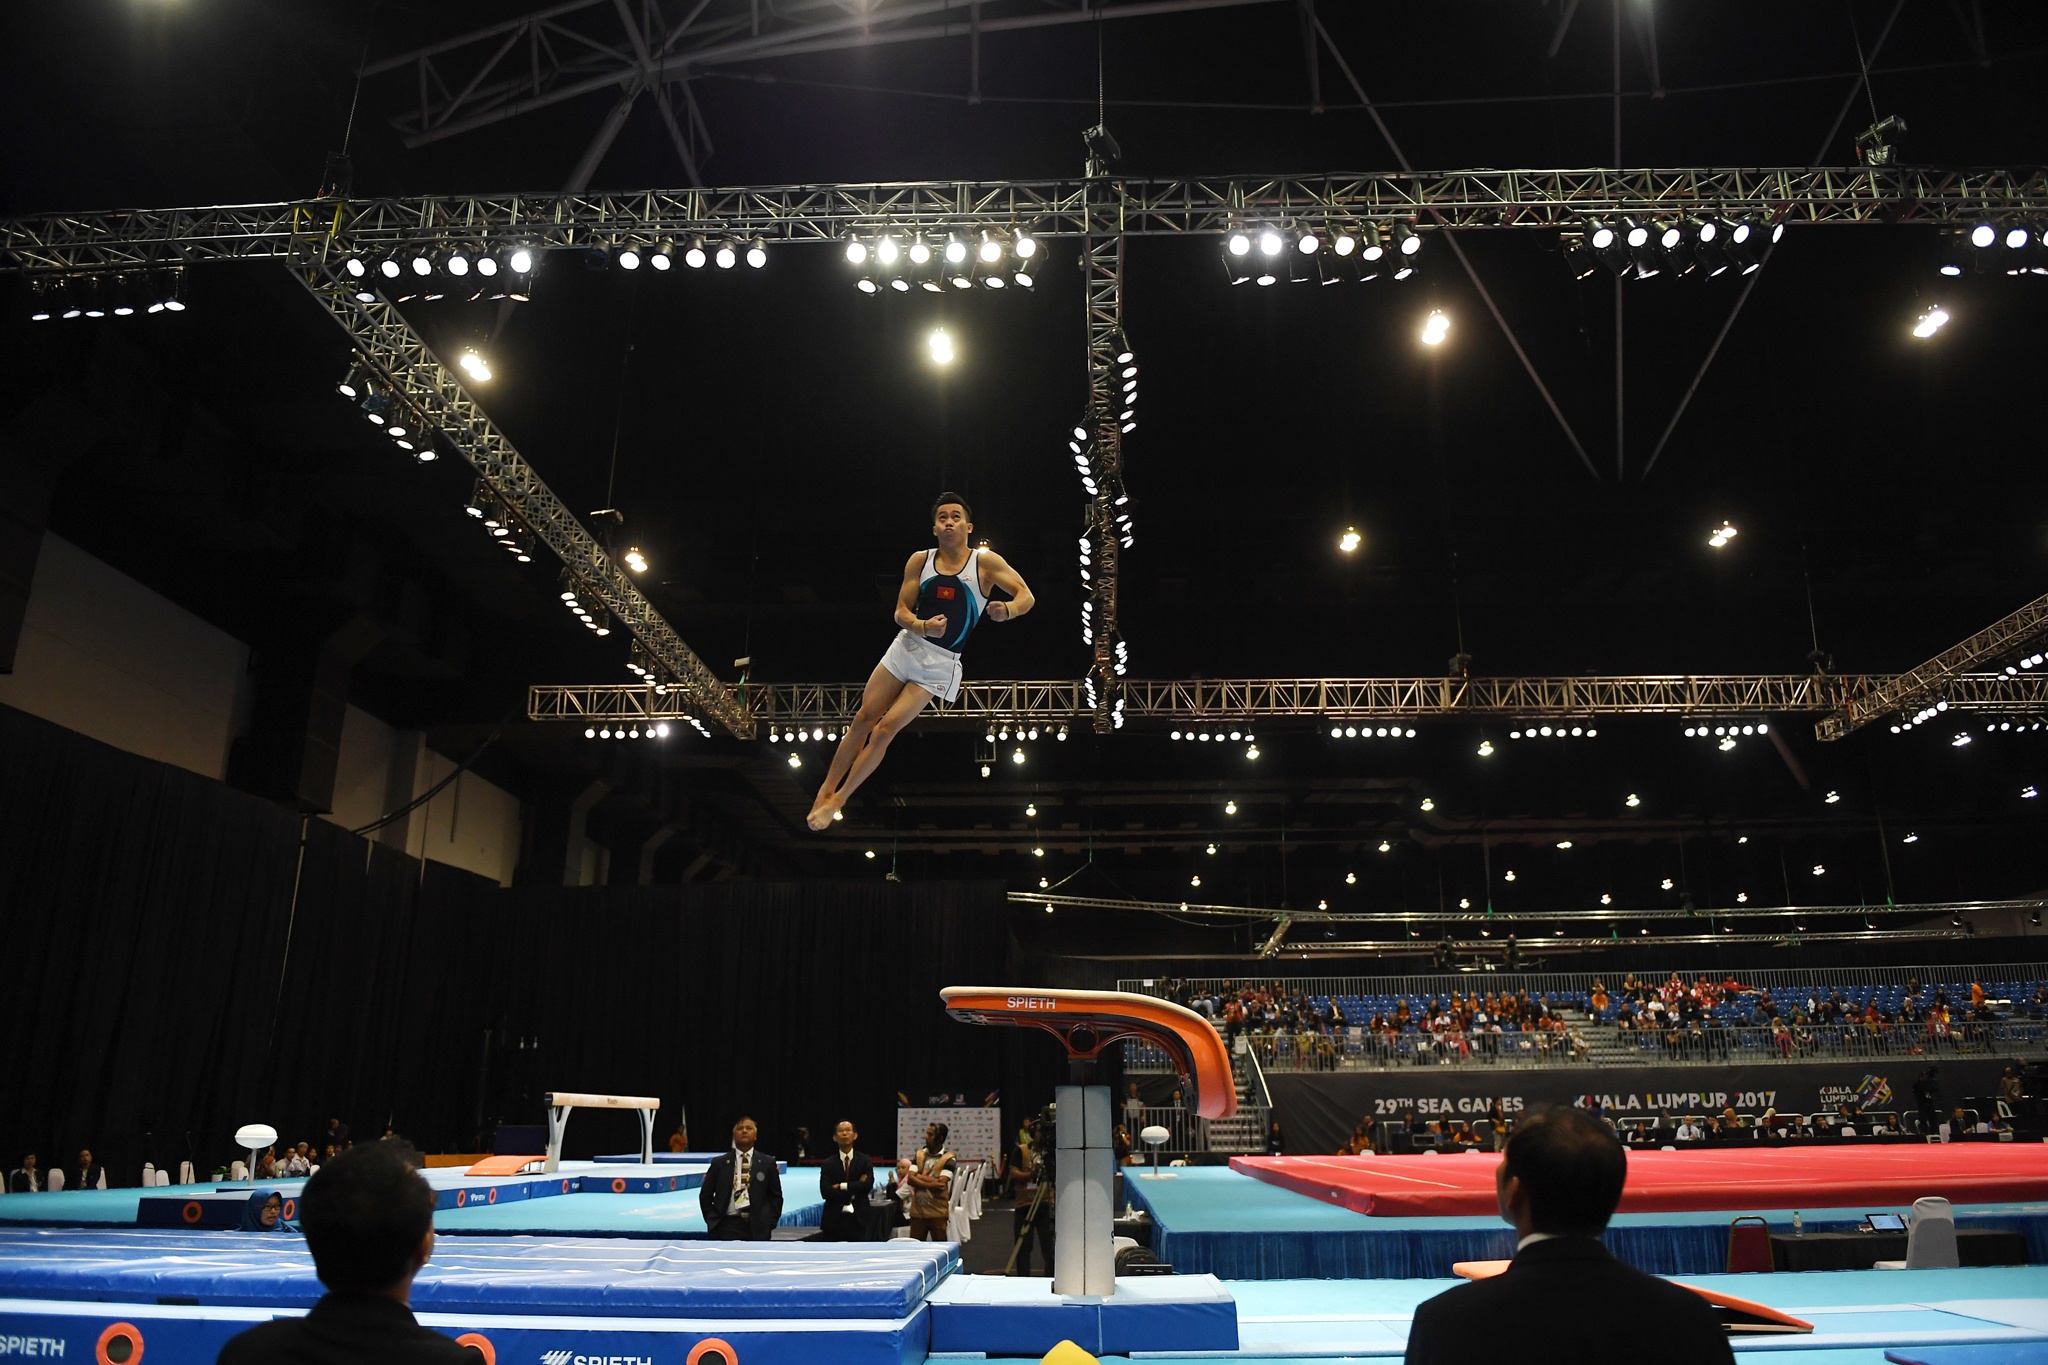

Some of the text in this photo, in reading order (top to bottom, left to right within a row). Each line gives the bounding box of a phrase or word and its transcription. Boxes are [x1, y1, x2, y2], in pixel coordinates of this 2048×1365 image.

[1007, 996, 1056, 1010] SPIETH
[1820, 1086, 1852, 1095] KUALA
[1572, 1090, 1777, 1110] KUALA LUMPUR 2017
[1820, 1094, 1860, 1103] LUMPUR
[1375, 1098, 1413, 1115] 29TH
[1417, 1098, 1455, 1114] SEA
[0, 1335, 66, 1357] SPIETH
